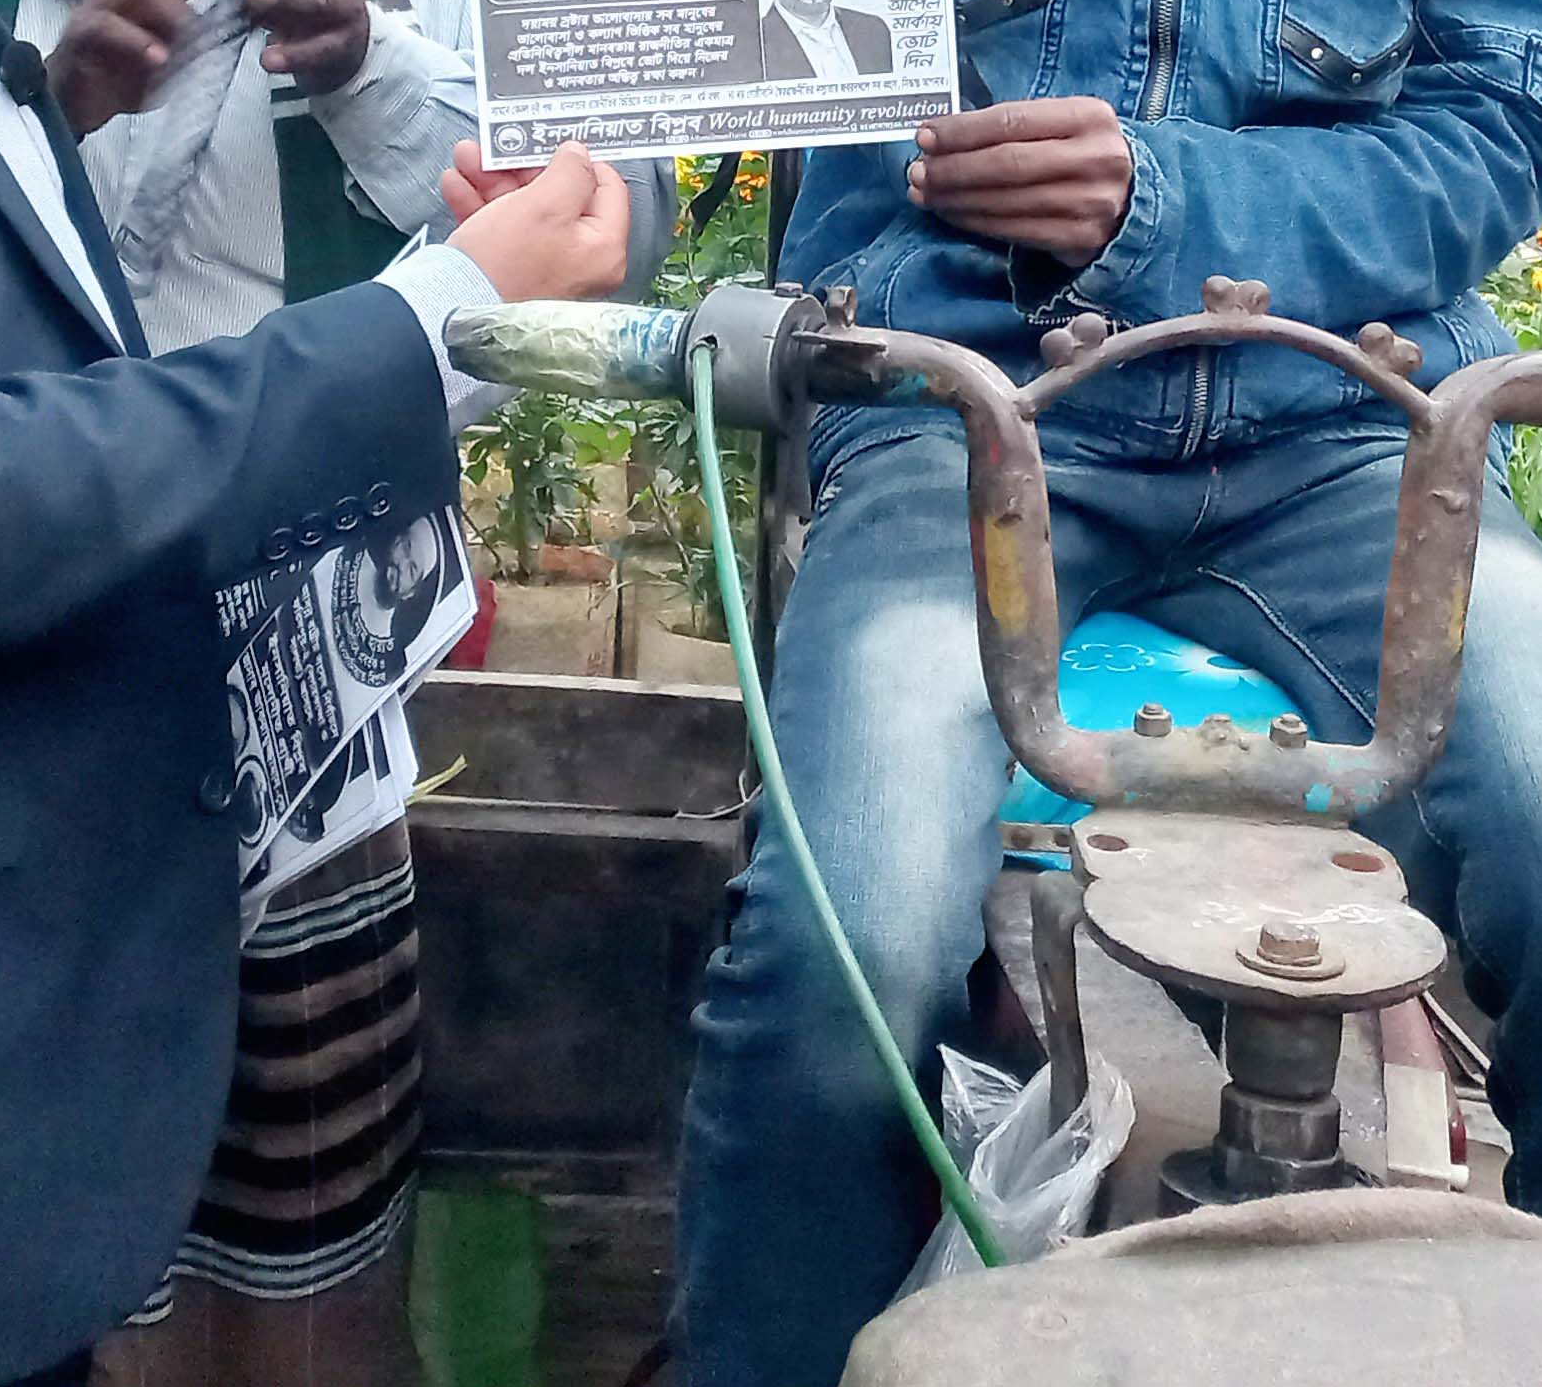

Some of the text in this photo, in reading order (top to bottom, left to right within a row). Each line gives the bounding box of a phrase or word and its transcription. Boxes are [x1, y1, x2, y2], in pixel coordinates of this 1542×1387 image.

[896, 30, 939, 50] ভোট
[903, 50, 936, 69] দিন
[530, 116, 646, 144] ইনসানিয়াত
[650, 113, 705, 136] বিপ্লব
[708, 110, 764, 131] World
[768, 104, 856, 127] humanity
[860, 99, 950, 120] revolution
